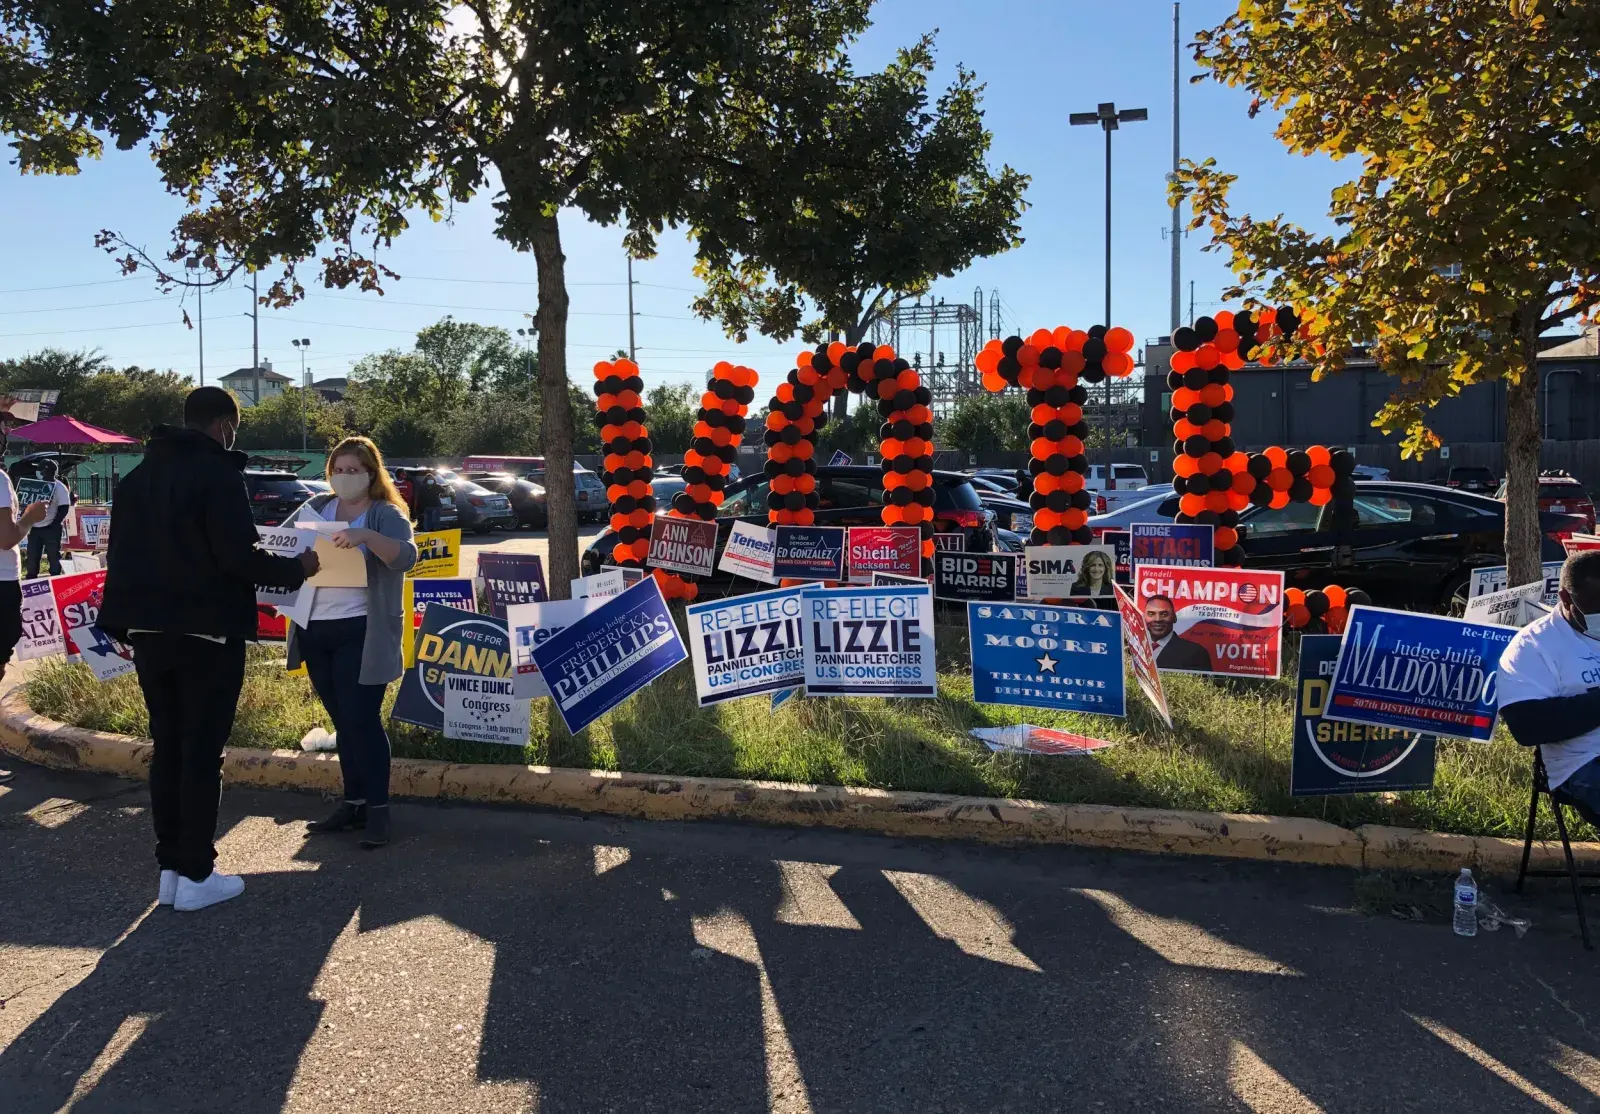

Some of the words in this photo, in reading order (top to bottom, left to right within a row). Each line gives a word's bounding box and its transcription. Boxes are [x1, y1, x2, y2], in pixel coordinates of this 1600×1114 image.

[662, 523, 689, 543] ANN
[1134, 526, 1171, 537] JUDGE
[268, 535, 298, 548] 2020
[1134, 537, 1201, 559] STACI
[649, 539, 714, 567] JOHNSON
[776, 546, 789, 558] ED
[789, 547, 832, 560] GONZALEZ
[852, 545, 899, 560] Sheila
[851, 561, 890, 570] Jackson
[893, 561, 911, 570] Lee
[942, 558, 1007, 576] BIDEN
[1029, 559, 1077, 575] SIMA
[941, 573, 1008, 589] HARRIS
[1142, 570, 1173, 579] Wendell
[488, 578, 541, 594] TRUMP
[1140, 578, 1278, 604] CHAMPION
[496, 591, 535, 604] PENCE
[1470, 598, 1490, 609] EXPECT
[1490, 593, 1504, 604] MORE
[1510, 590, 1519, 598] THE
[1519, 586, 1531, 597] NEXT
[1530, 584, 1543, 594] FOUR
[812, 597, 918, 620] RE-ELECT
[977, 606, 1113, 628] SANDRA
[1202, 605, 1227, 613] Congress
[1206, 611, 1232, 619] DISTRICT
[461, 629, 484, 643] VOTE
[484, 635, 502, 647] FOR
[575, 626, 606, 650] Re-Elect
[605, 612, 627, 633] Judge
[813, 619, 921, 653] LIZZIE
[1030, 623, 1059, 638] G.
[1462, 626, 1512, 644] Re-Elect
[33, 638, 56, 648] Texas
[559, 610, 651, 676] FREDERICKA
[703, 617, 804, 665] LIZZI
[984, 633, 1108, 655] MOORE
[552, 613, 670, 702] PHILLIPS
[815, 654, 861, 665] PANNILL
[864, 653, 922, 665] FLETCHER
[1215, 643, 1269, 660] VOTE!
[1392, 639, 1440, 662] Judge
[1441, 646, 1482, 667] Julia
[102, 667, 118, 677] FOR
[577, 682, 595, 700] 61st
[593, 671, 613, 690] Civil
[610, 657, 638, 680] District
[637, 640, 661, 662] Court
[708, 659, 757, 676] PANNILL
[1339, 621, 1498, 706] MALDONADO
[709, 673, 737, 687] U.S.
[815, 666, 842, 679] U.S.
[845, 666, 922, 679] CONGRESS
[990, 671, 1044, 684] TEXAS
[1049, 676, 1106, 689] HOUSE
[447, 677, 480, 693] VINCE
[994, 686, 1076, 701] DISTRICT
[1081, 694, 1104, 703] 133
[462, 697, 511, 713] Congress
[1352, 697, 1378, 710] 507th
[1379, 701, 1431, 718] DISTRICT
[1431, 708, 1470, 724] COURT
[1414, 696, 1466, 711] DEMOCRAT
[457, 721, 482, 732] Congress
[486, 724, 499, 732] 18th
[499, 725, 523, 735] DISTRICT
[1330, 751, 1360, 768] HARRIS
[1369, 746, 1399, 768] COUNTY
